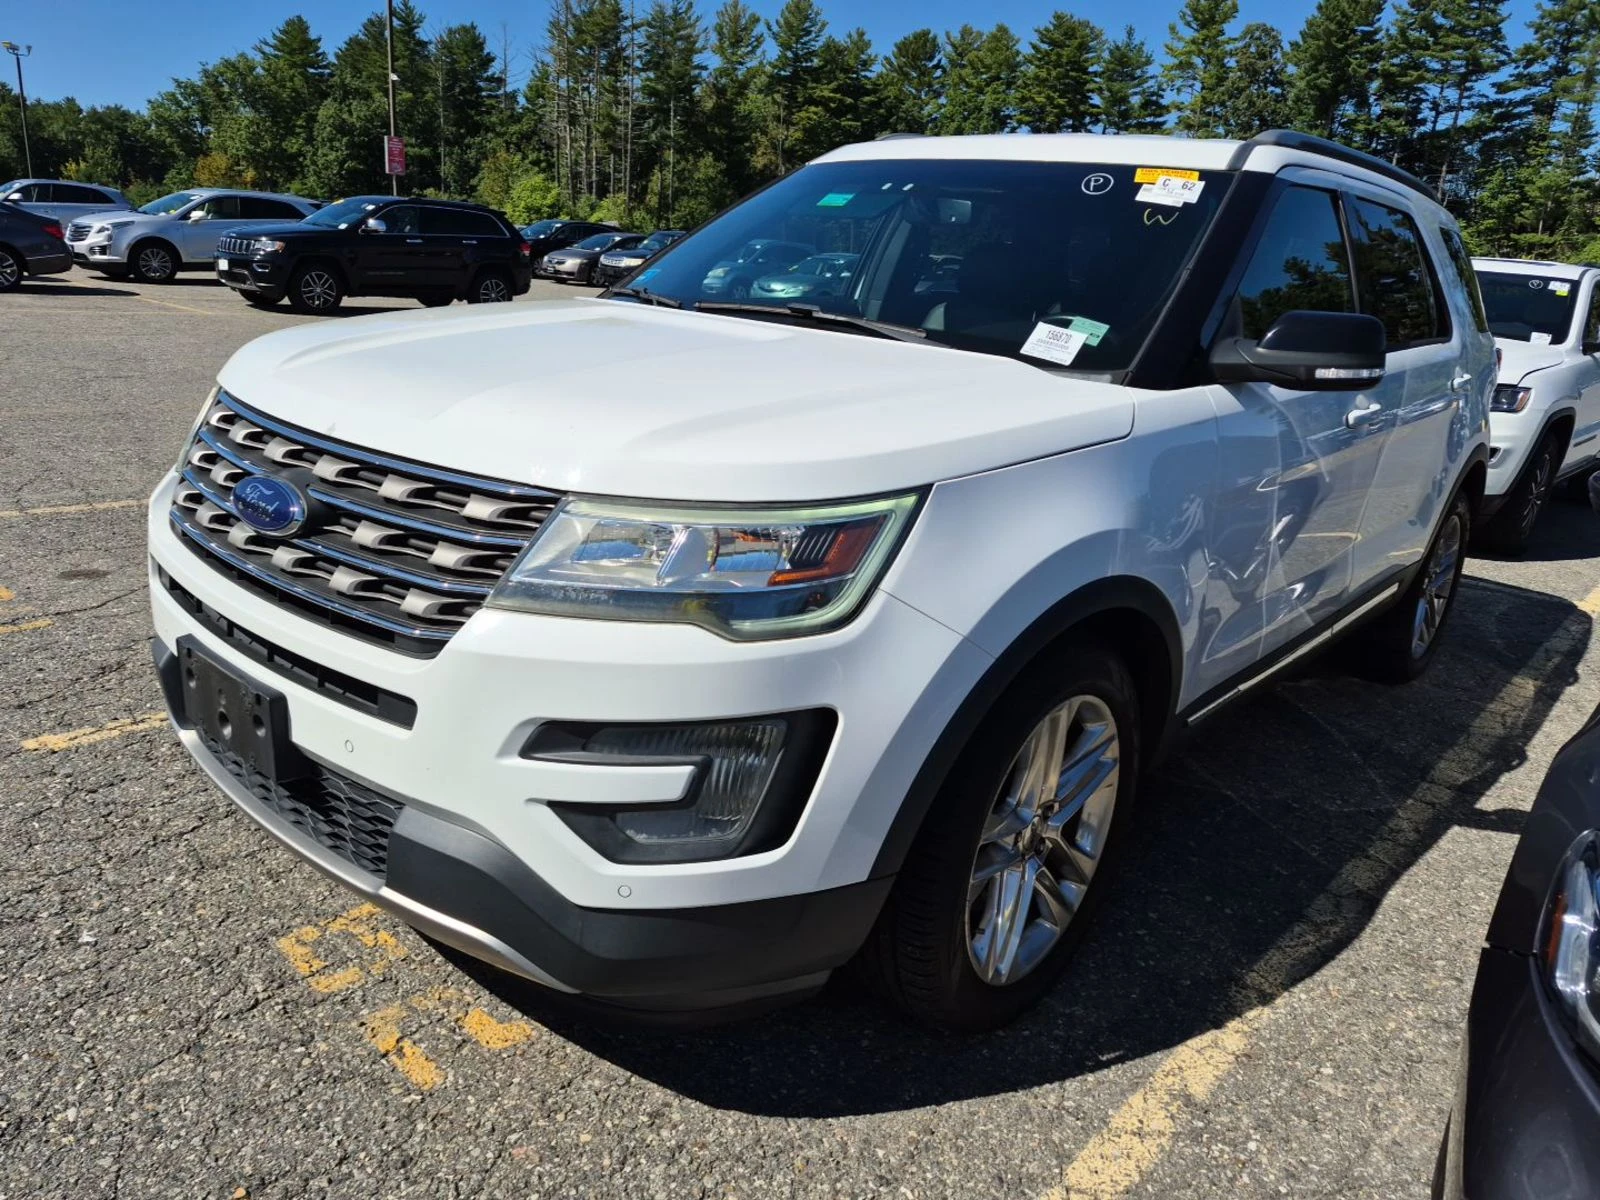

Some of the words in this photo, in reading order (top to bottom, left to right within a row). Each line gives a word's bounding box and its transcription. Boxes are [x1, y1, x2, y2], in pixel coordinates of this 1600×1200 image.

[1162, 178, 1171, 188] C
[1181, 181, 1196, 191] 62
[1047, 330, 1072, 344] 156870
[245, 482, 280, 513] Ford
